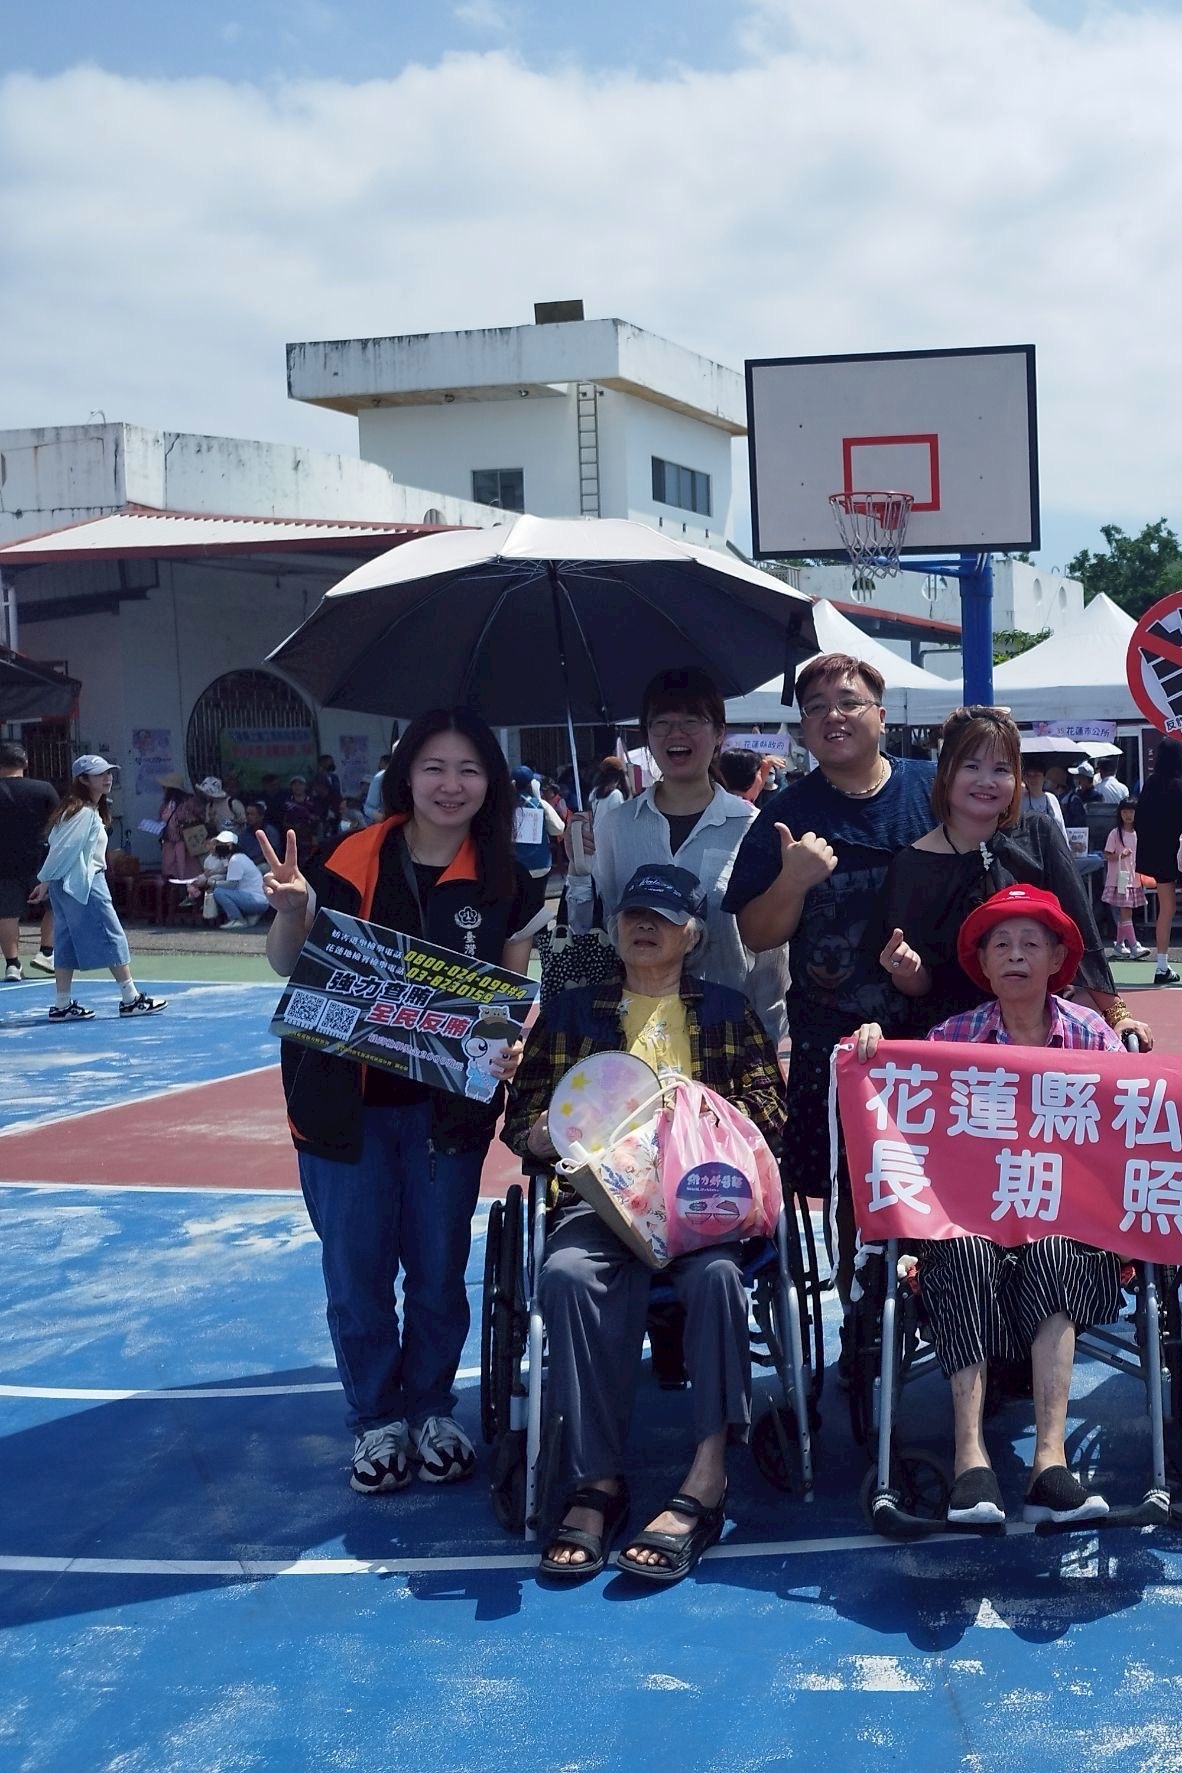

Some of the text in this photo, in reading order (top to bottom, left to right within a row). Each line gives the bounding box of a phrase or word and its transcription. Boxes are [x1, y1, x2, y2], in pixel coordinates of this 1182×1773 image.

[325, 969, 436, 1008] 強力查賄
[403, 950, 529, 1000] 0800-024-099#4
[405, 967, 495, 1004] 03-8230159
[364, 1001, 475, 1039] 全民反賄
